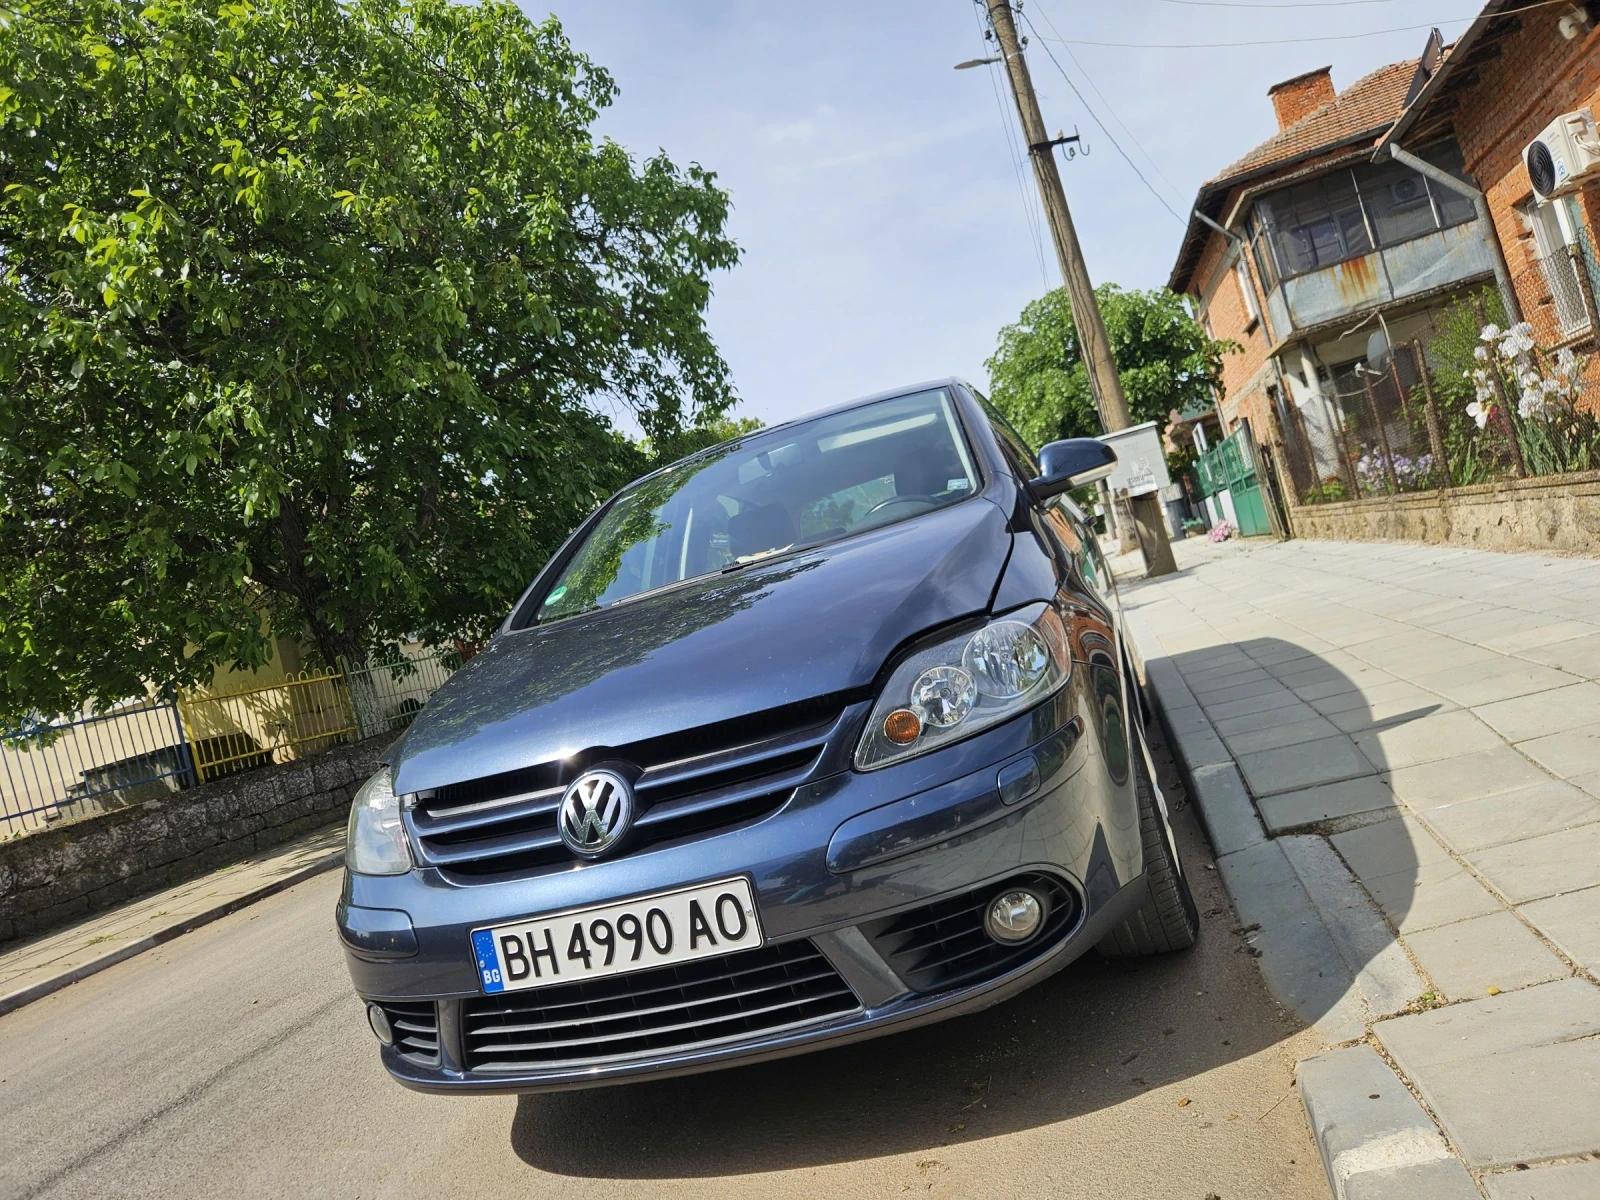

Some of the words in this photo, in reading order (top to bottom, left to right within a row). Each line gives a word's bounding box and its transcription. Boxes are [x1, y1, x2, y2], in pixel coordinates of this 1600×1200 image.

[499, 928, 559, 982] BH
[567, 907, 673, 969] 4990
[689, 893, 747, 950] AO
[482, 968, 501, 984] BG
